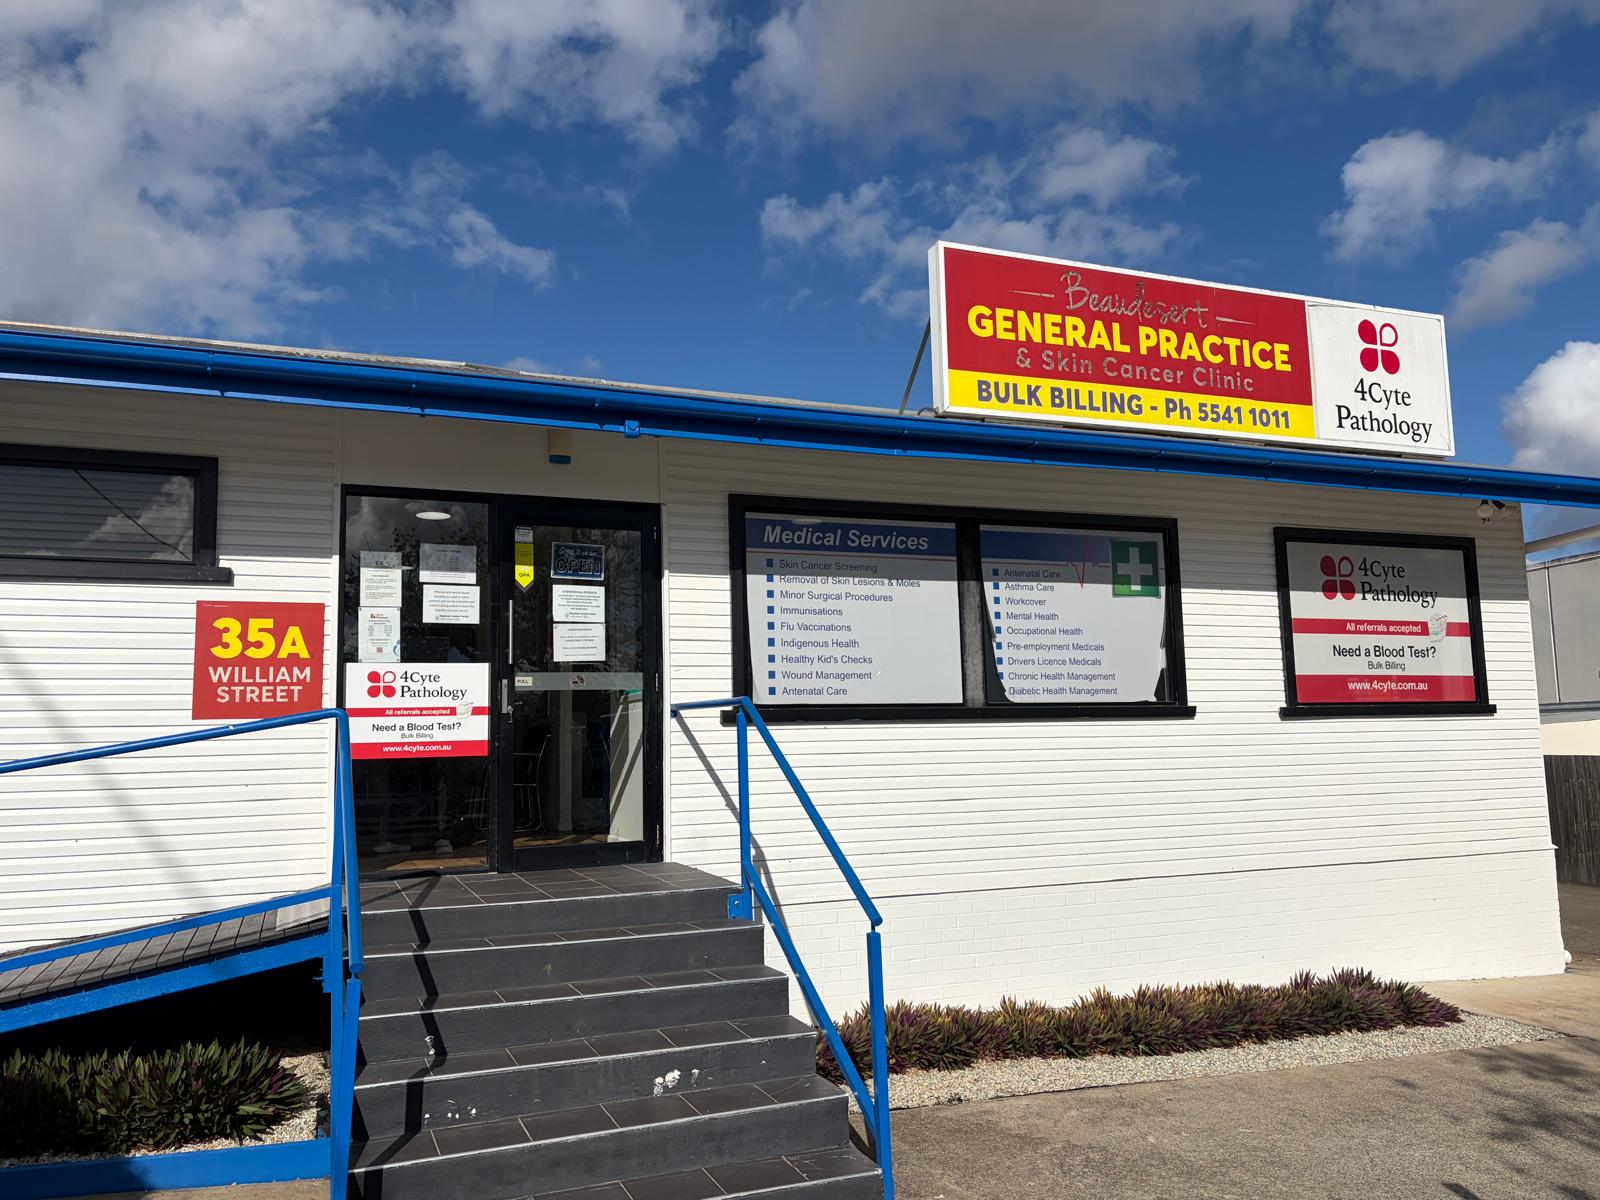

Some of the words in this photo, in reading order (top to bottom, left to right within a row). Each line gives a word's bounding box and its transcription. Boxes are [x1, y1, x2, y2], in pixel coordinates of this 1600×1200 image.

[1060, 271, 1208, 328] Beaudesert
[967, 304, 1131, 353] GENERAL
[1138, 325, 1292, 372] PRACTICE
[1016, 347, 1031, 368] &
[1041, 350, 1092, 374] Skin
[1102, 356, 1184, 383] Cancer
[1192, 366, 1255, 391] Clinic
[1354, 378, 1412, 410] 4Cyte
[977, 379, 1043, 407] BULK
[1050, 386, 1143, 416] BILLING
[1165, 397, 1191, 421] Ph
[1198, 402, 1243, 425] 5541
[1248, 407, 1290, 429] 1011
[1335, 404, 1433, 443] Pathology
[764, 525, 841, 546] Medical
[848, 530, 928, 549] Services
[556, 558, 600, 575] OPEN
[779, 560, 798, 569] Skin
[802, 561, 831, 570] Cancer
[835, 562, 878, 573] Screening
[1358, 557, 1405, 582] 4Cyte
[1004, 569, 1040, 577] Antenatal
[1042, 569, 1061, 578] Care
[780, 576, 818, 584] Removal
[821, 576, 829, 584] of
[832, 576, 850, 585] Skin
[853, 577, 885, 587] Lesions
[896, 578, 920, 588] Moles
[1005, 582, 1034, 591] Asthma
[1036, 583, 1054, 592] Care
[780, 591, 804, 600] Minor
[808, 591, 842, 602] Surgical
[845, 592, 893, 602] Procedures
[1360, 581, 1438, 608] Pathology
[1005, 597, 1046, 606] Workcover
[780, 606, 843, 616] Immunisations
[1006, 612, 1032, 620] Mental
[1034, 613, 1058, 621] Health
[781, 622, 794, 631] Flu
[797, 623, 851, 632] Vaccinations
[1007, 627, 1056, 637] Occupational
[1059, 627, 1083, 636] Health
[1357, 623, 1387, 632] referrals
[1389, 625, 1421, 633] accepted
[210, 617, 311, 659] 35A
[781, 638, 829, 649] Indigenous
[832, 639, 859, 648] Health
[1008, 642, 1070, 652] Pre-employment
[1333, 645, 1360, 657] Need
[1365, 649, 1371, 657] a
[1374, 646, 1404, 658] Blood
[1407, 646, 1436, 658] Test?
[782, 654, 814, 665] Healthy
[818, 655, 838, 663] Kid's
[841, 655, 872, 664] Checks
[1008, 657, 1036, 665] Drivers
[1038, 658, 1067, 666] Licence
[1385, 662, 1406, 671] Billing
[208, 666, 311, 683] WILLIAM
[400, 671, 440, 685] 4Cyte
[782, 671, 812, 679] Wound
[816, 671, 872, 682] Management
[1008, 672, 1038, 680] Chronic
[1041, 672, 1065, 680] Health
[1068, 673, 1116, 682] Management
[782, 687, 824, 695] Antenatal
[827, 687, 848, 695] Care
[1348, 681, 1428, 691] www.4cyte.com.au
[216, 686, 303, 703] STREET
[400, 686, 467, 700] Pathology
[1009, 687, 1040, 695] Diabetic
[1043, 687, 1067, 695] Health
[1069, 687, 1118, 697] Management
